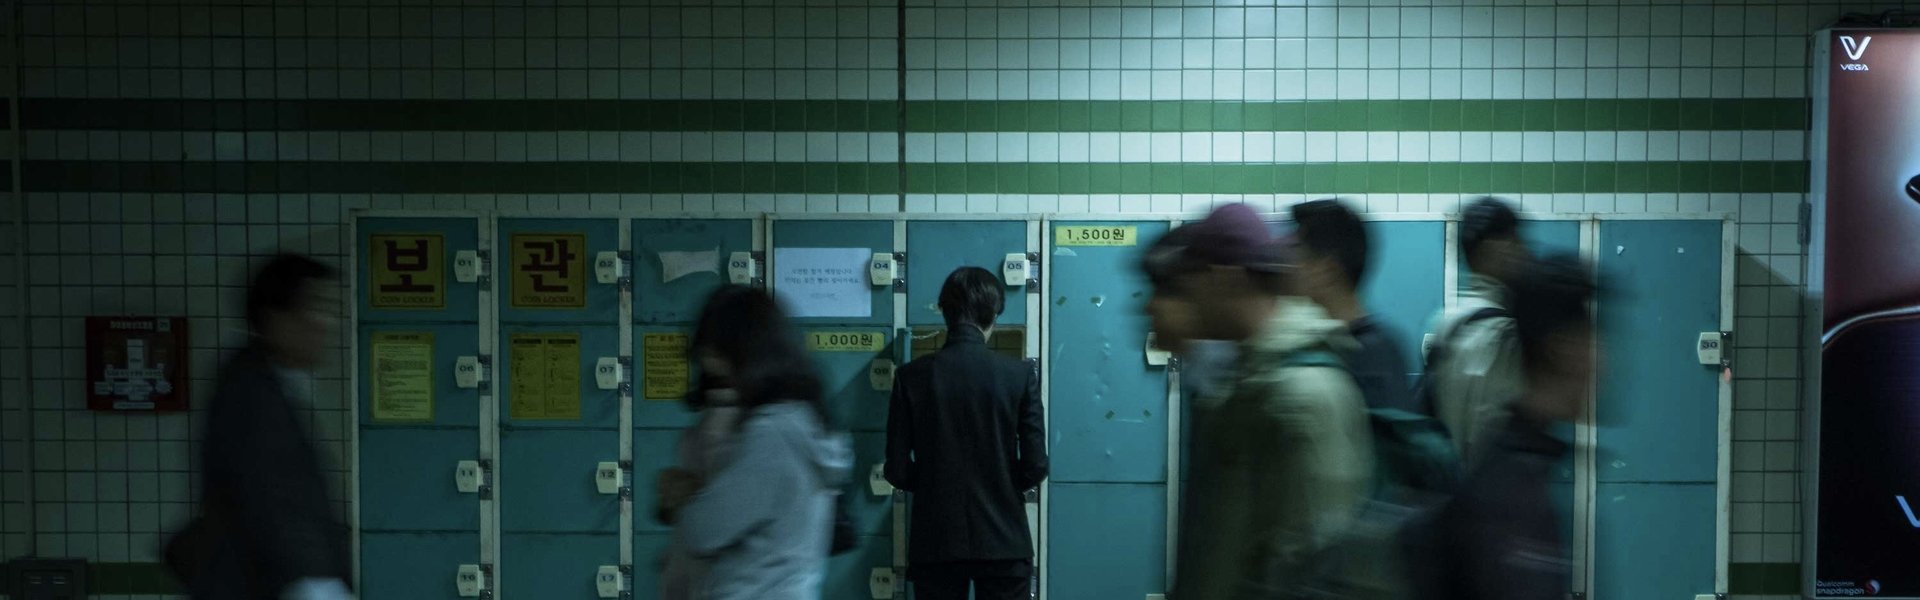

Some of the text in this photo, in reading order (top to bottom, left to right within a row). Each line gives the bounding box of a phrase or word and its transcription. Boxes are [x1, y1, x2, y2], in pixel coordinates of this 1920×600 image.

[1066, 228, 1125, 241] 1,500원
[379, 239, 435, 293] 보
[457, 259, 473, 267] 01
[520, 238, 576, 293] 관
[598, 260, 614, 268] 02
[731, 260, 748, 269] 03
[873, 262, 889, 270] 04
[1006, 262, 1023, 271] 05
[815, 333, 873, 347] 1,000원
[599, 366, 614, 374] 07
[461, 469, 473, 477] 11
[600, 470, 616, 478] 12
[601, 574, 615, 582] 17
